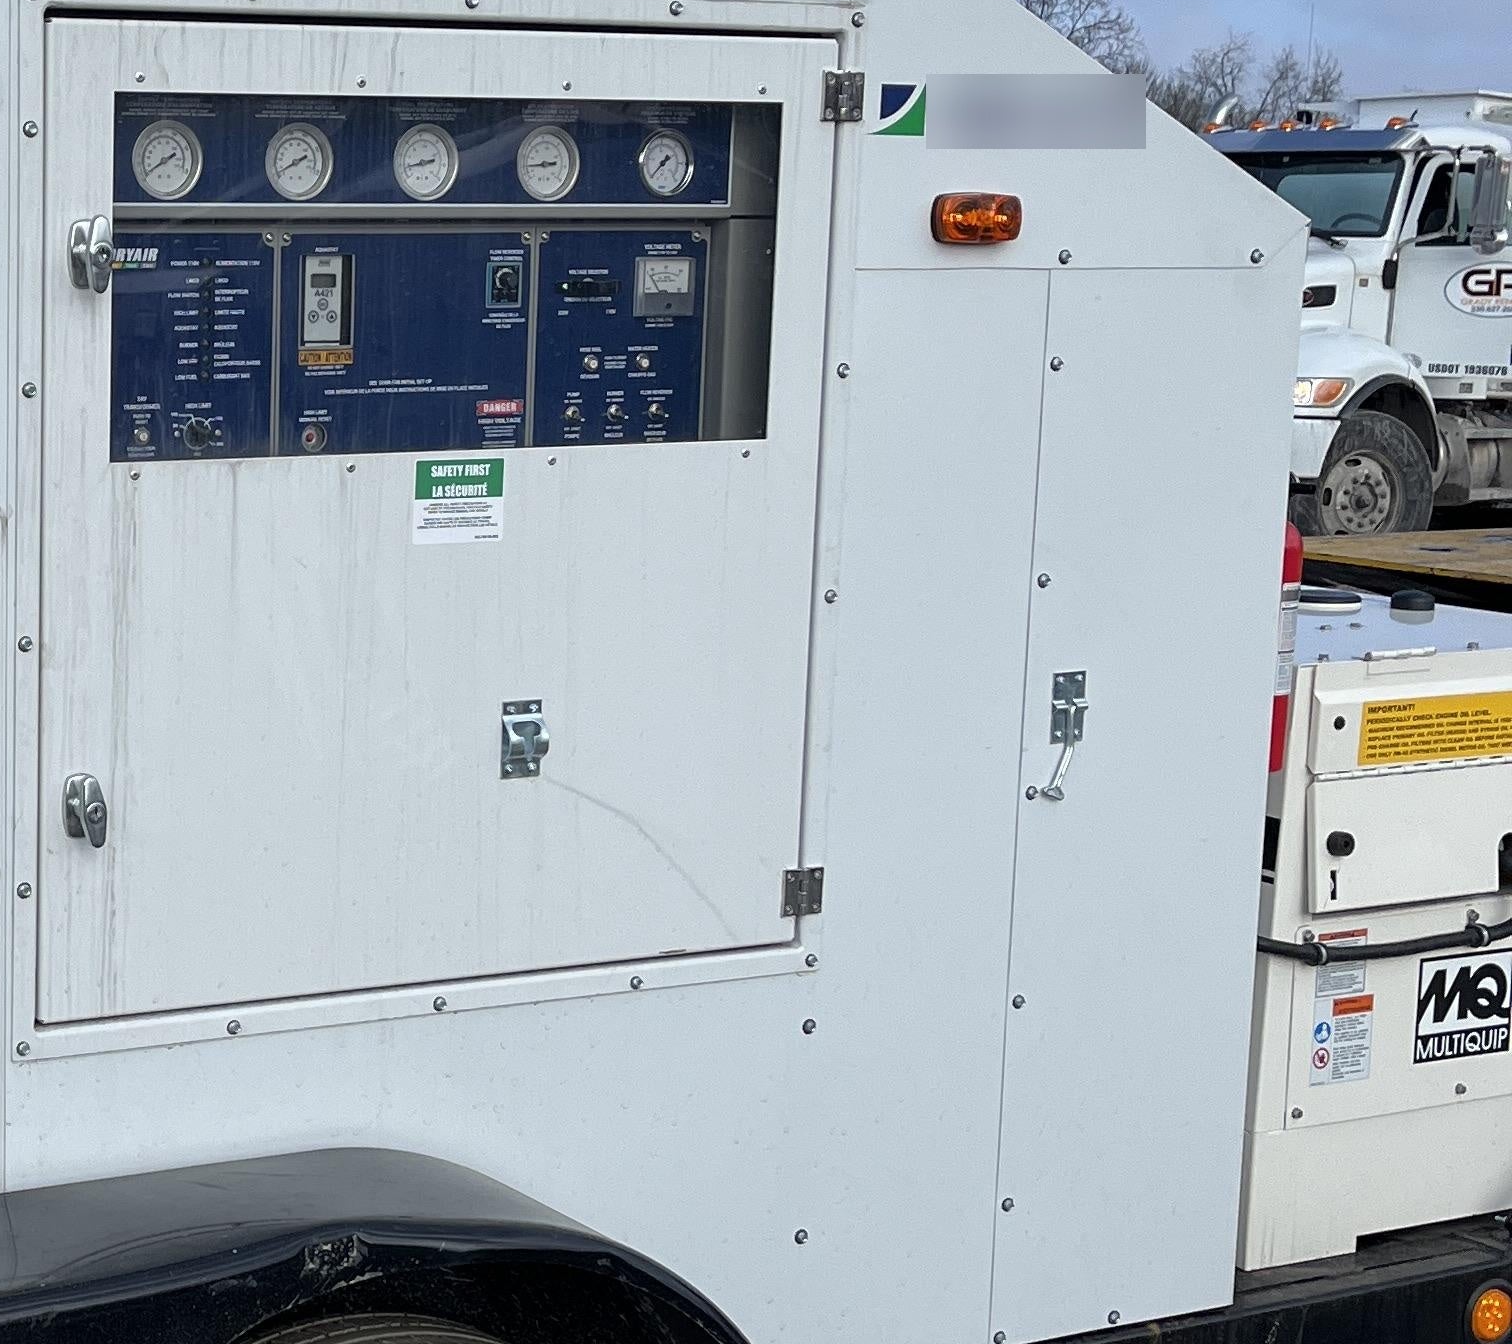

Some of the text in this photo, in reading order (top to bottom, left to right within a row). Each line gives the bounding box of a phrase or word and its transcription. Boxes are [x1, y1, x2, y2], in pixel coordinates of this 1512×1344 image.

[113, 248, 159, 262] RYAIR
[1428, 363, 1460, 374] USDOT
[483, 402, 518, 413] DANGER
[430, 463, 491, 477] SAFETY FIRST
[432, 482, 488, 497] LA SÉCURITÉ
[1368, 703, 1416, 714] IMPORTANT!
[1418, 962, 1510, 1024] MQ
[1415, 1027, 1509, 1061] MULTIQUIP
